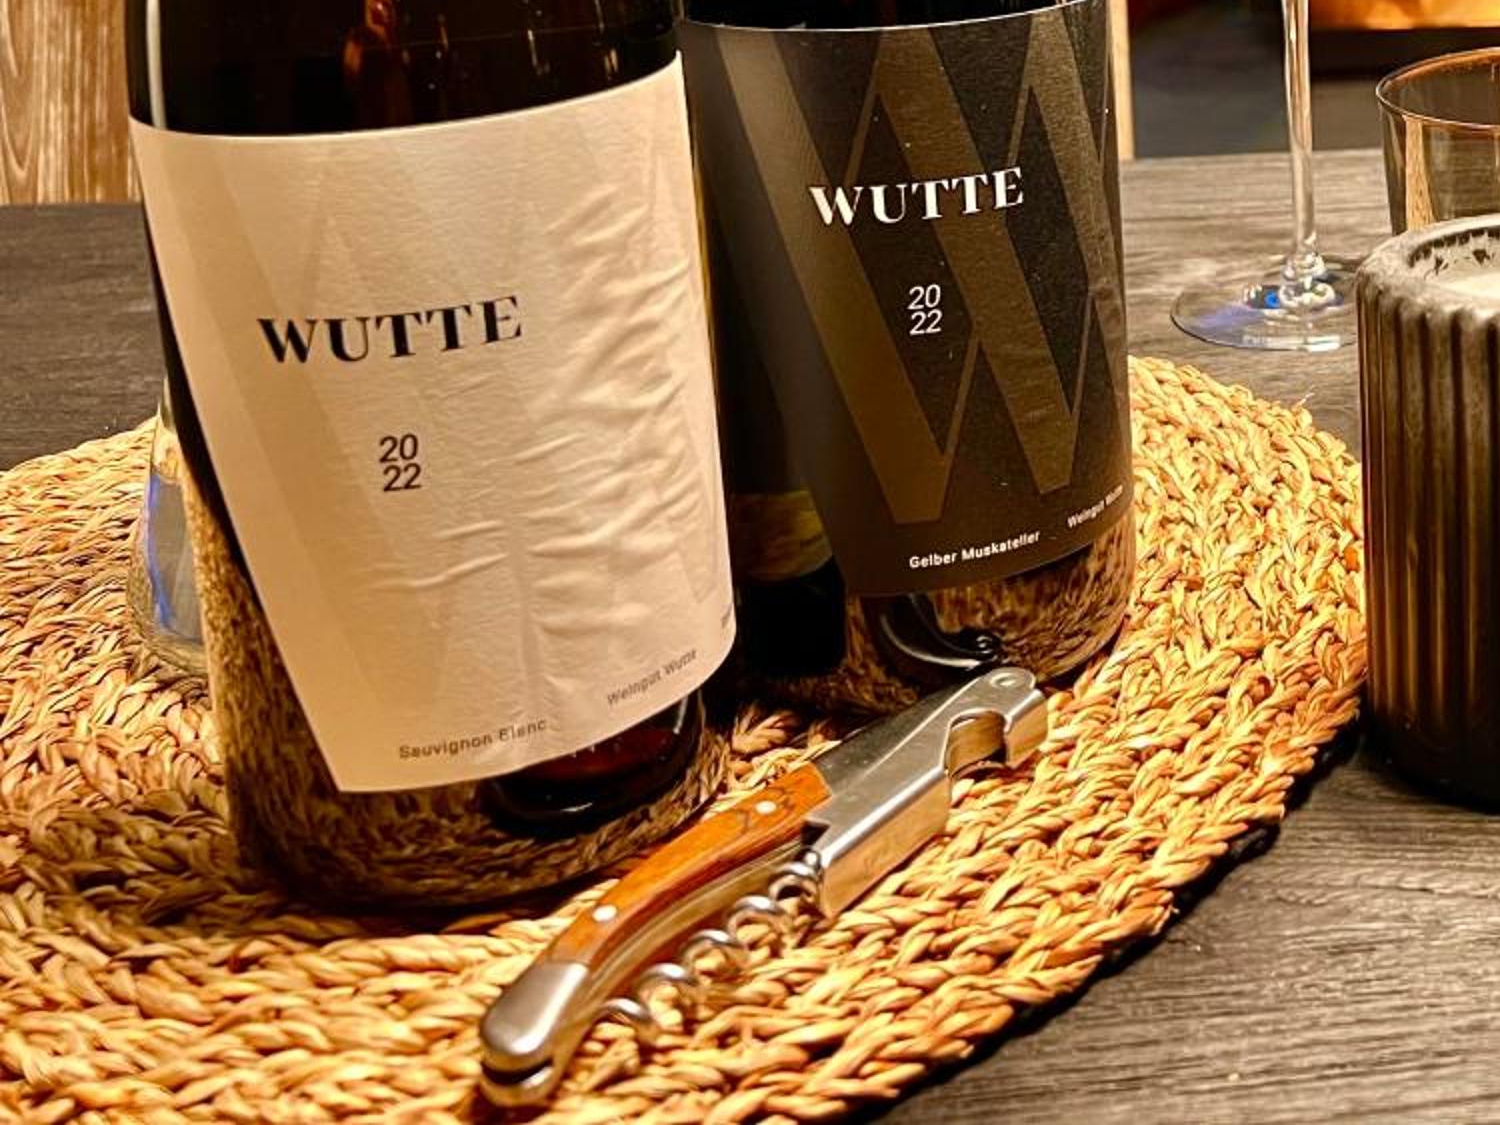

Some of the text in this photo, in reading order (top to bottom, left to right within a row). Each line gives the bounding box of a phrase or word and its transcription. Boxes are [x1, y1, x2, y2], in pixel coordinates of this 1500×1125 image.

[809, 166, 1024, 226] WUTTE
[908, 284, 942, 311] 20
[256, 295, 522, 364] WUTTE
[909, 309, 944, 336] 22
[378, 433, 419, 463] 20
[383, 462, 422, 492] 22
[908, 529, 1041, 570] Gelber Muskateller
[399, 732, 493, 759] Sauvignon
